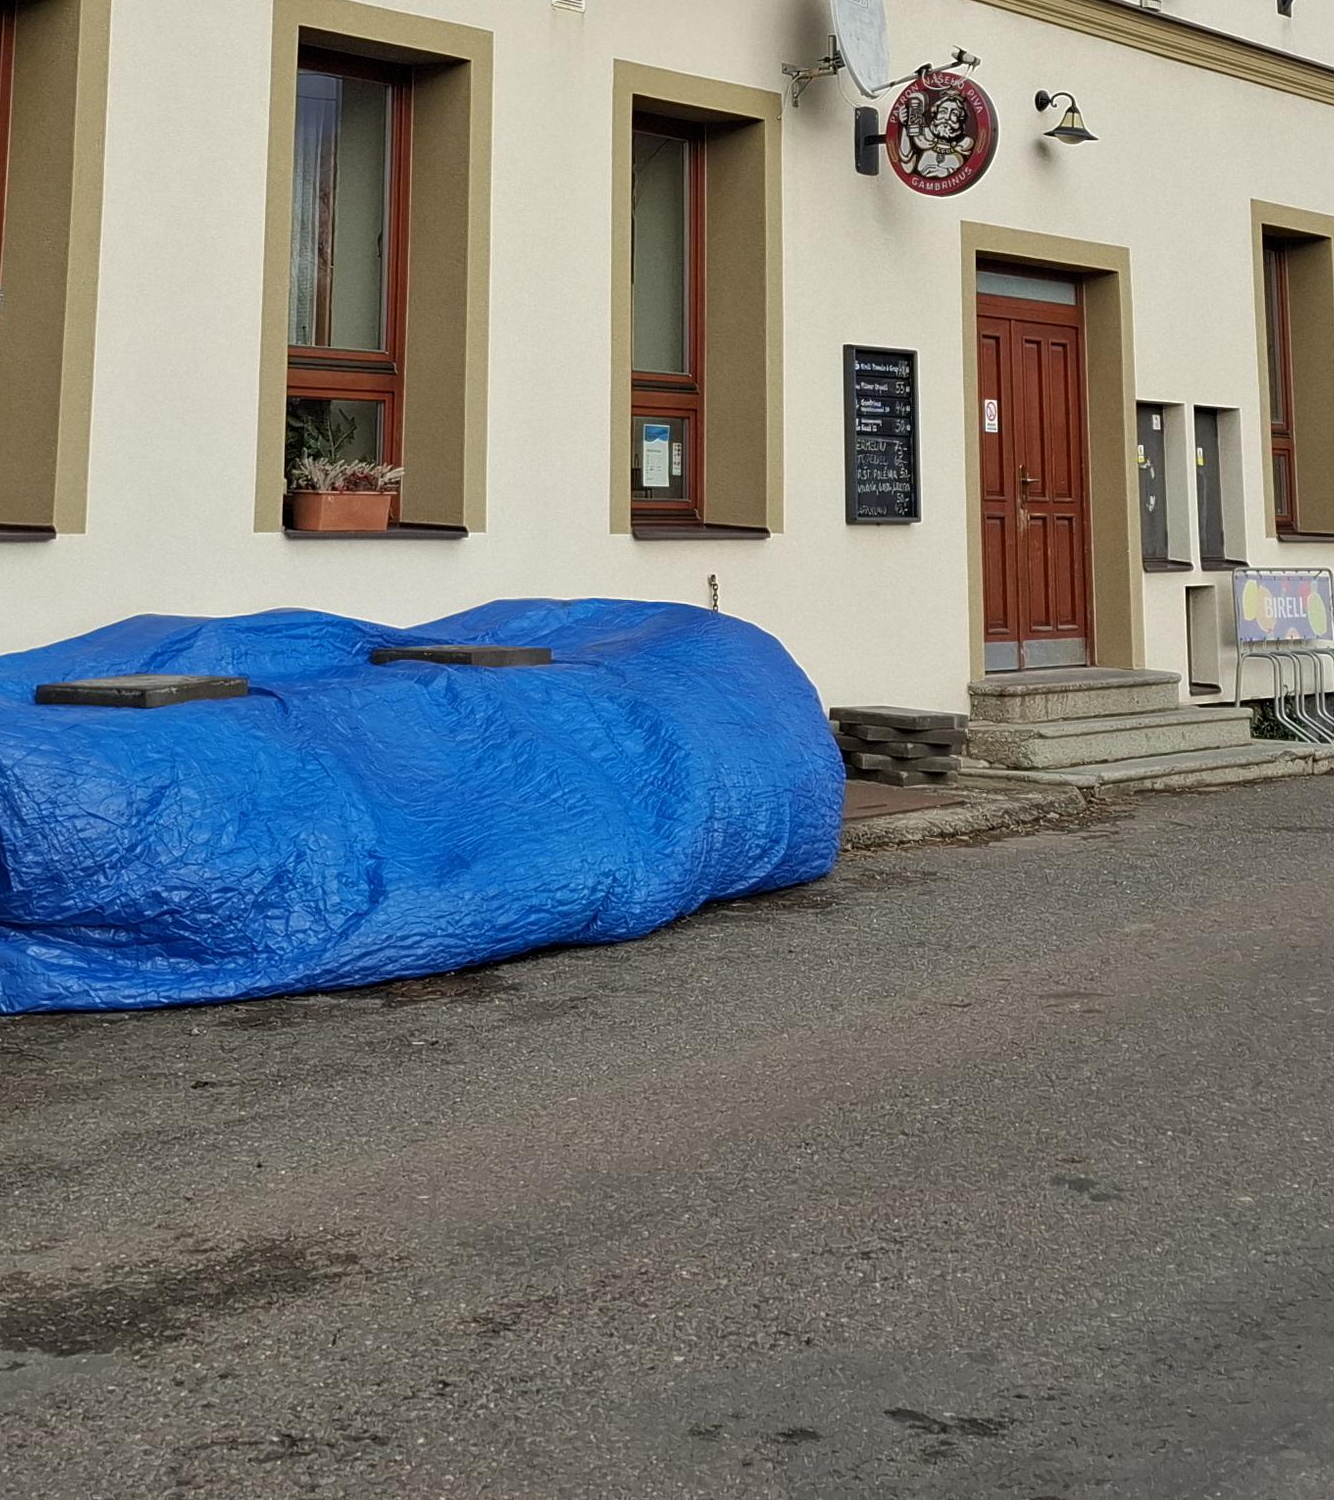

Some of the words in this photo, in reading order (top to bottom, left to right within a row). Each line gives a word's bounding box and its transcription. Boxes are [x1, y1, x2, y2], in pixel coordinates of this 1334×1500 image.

[890, 83, 919, 123] PATRON
[966, 89, 984, 114] PIVA
[911, 166, 972, 191] GAMBRINUS
[1263, 596, 1307, 619] BIRELL
